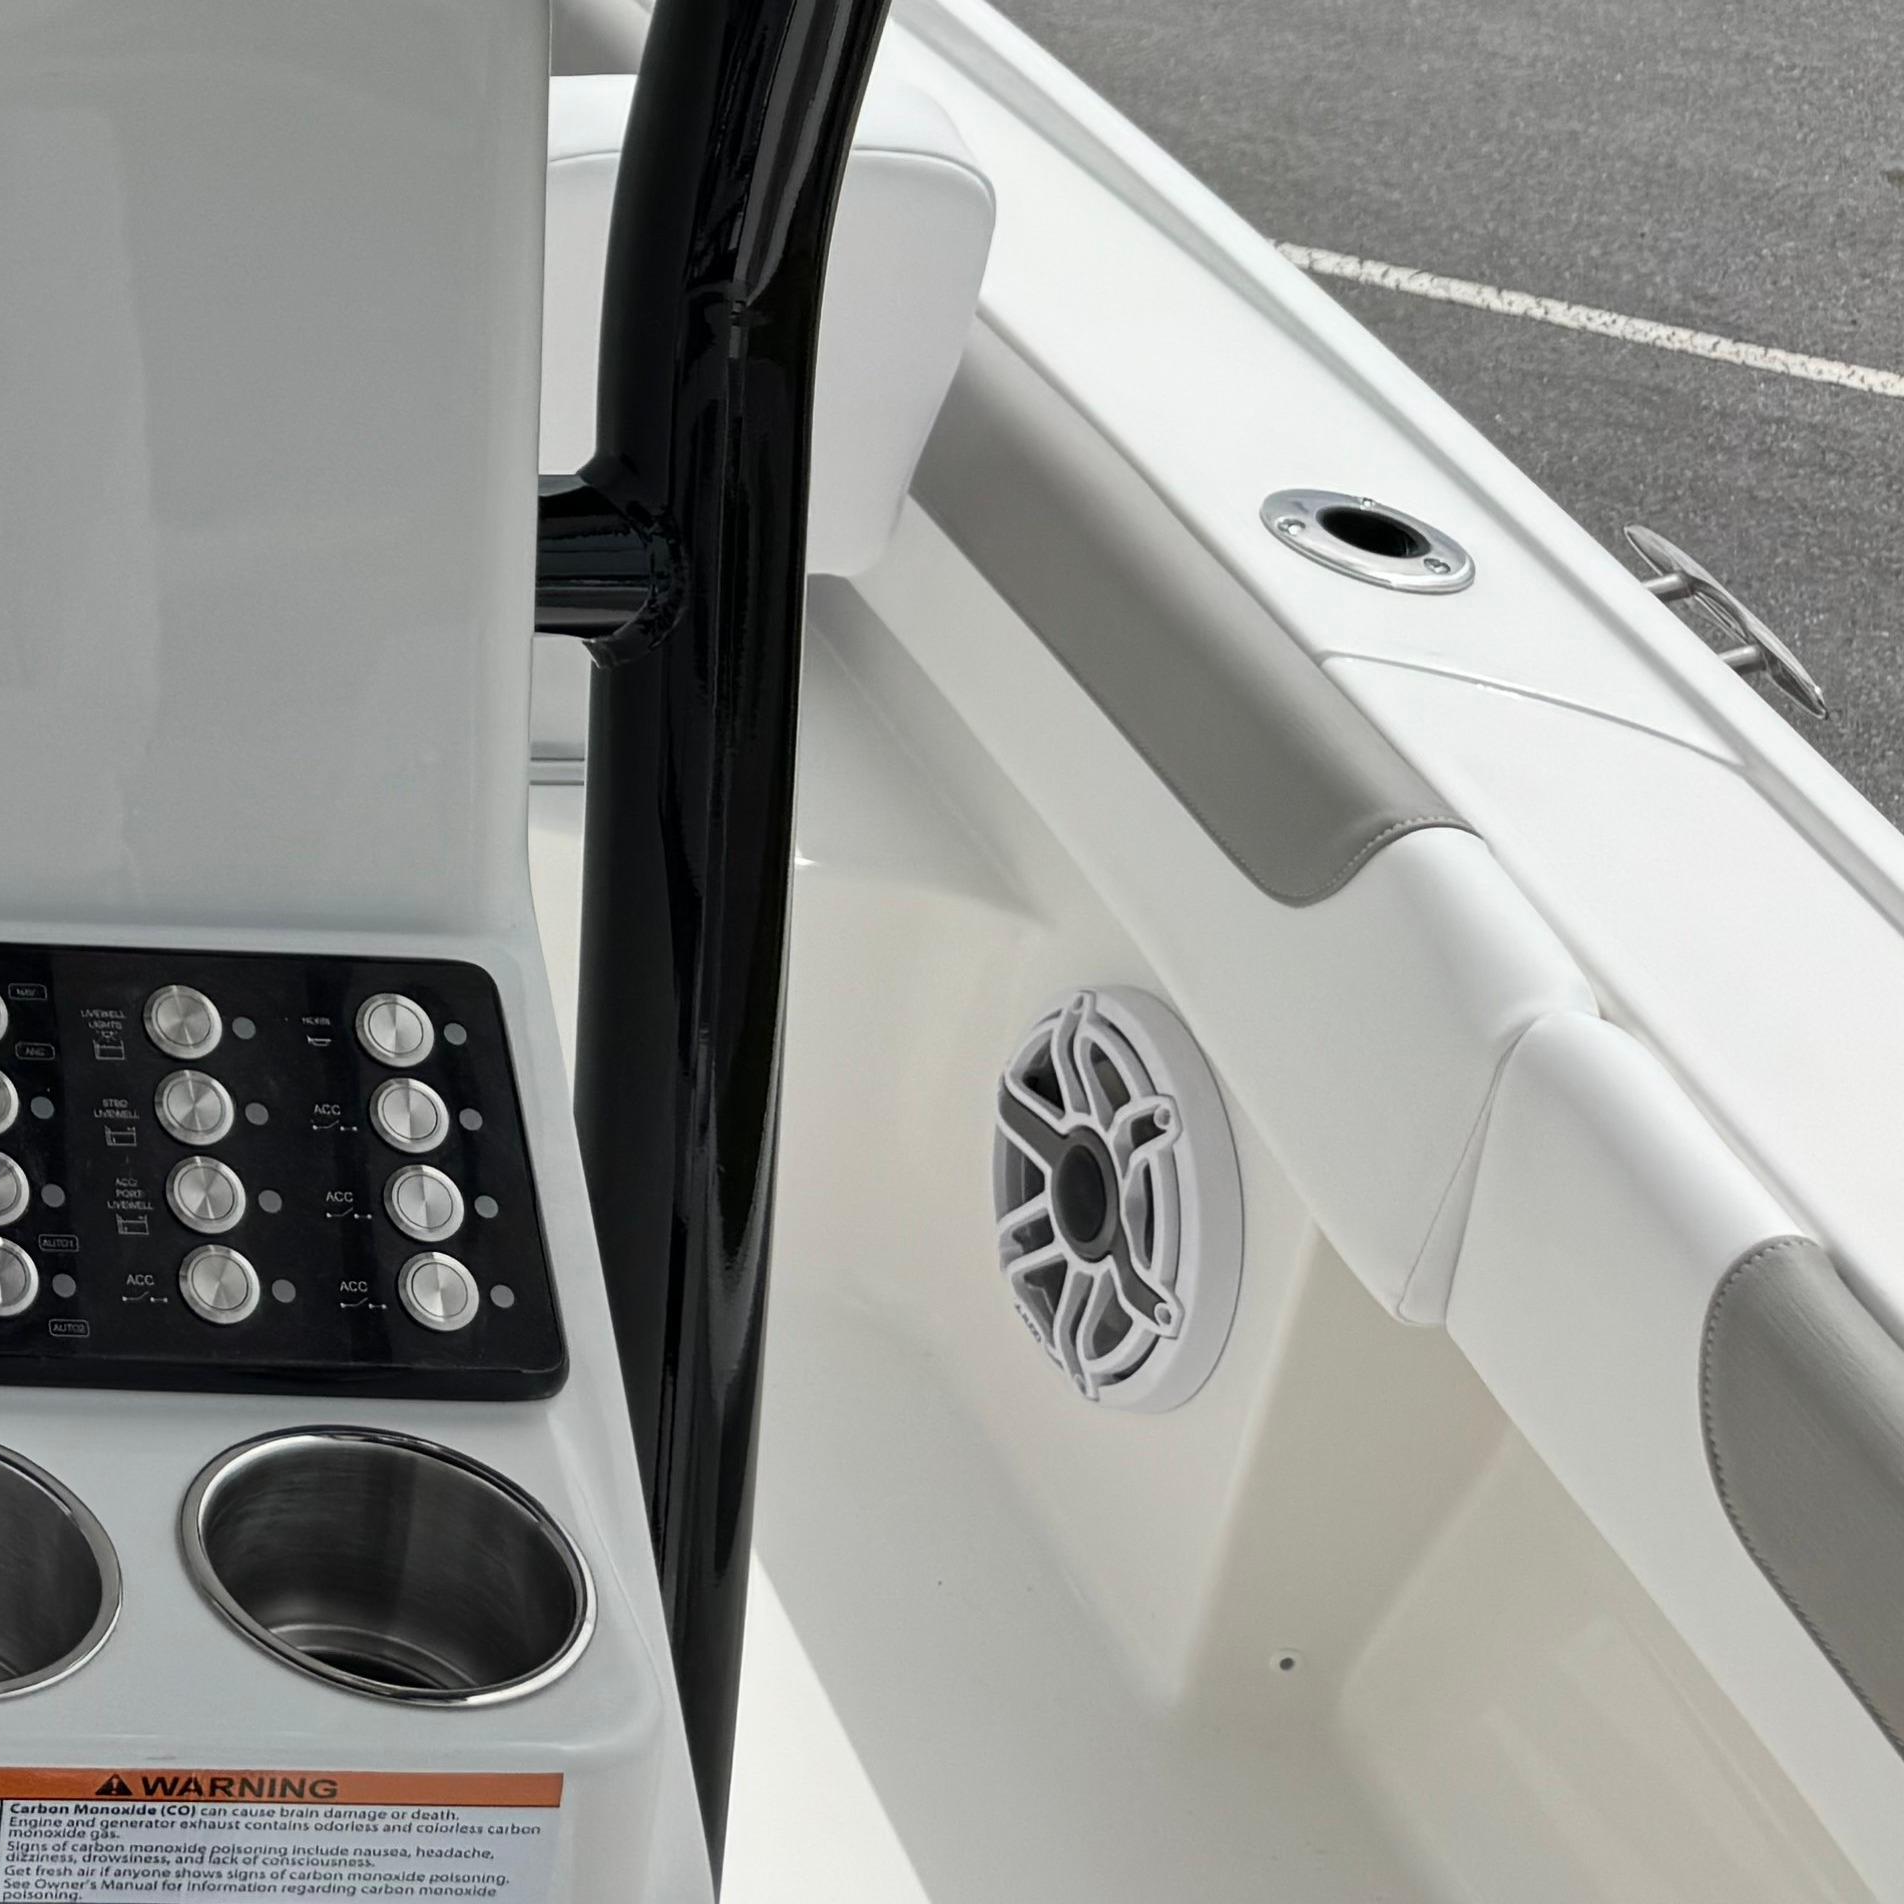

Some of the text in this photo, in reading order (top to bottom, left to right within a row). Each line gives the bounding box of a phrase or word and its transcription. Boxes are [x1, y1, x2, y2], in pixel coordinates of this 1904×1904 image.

[80, 1009, 127, 1019] LIVEWELL
[88, 1020, 123, 1030] LIGHTS
[93, 1109, 140, 1120] LIVEWELL
[313, 1103, 341, 1116] ACC
[116, 1189, 142, 1199] PORT
[325, 1191, 354, 1203] ACC
[107, 1200, 154, 1210] LIVEWELL
[126, 1274, 155, 1286] ACC
[339, 1280, 368, 1292] ACC
[141, 1776, 339, 1799] WARNING
[10, 1803, 460, 1821] Carbon Monoxide (CO) can cause brain damage or death.
[9, 1816, 541, 1835] Engine and generator exhaust contains odorless and colorless carbon
[8, 1828, 121, 1841] monoxide gas.
[7, 1841, 494, 1859] Signs of carbon monoxide poisoning include nausea, headache,
[6, 1852, 375, 1867] dizziness, drowsiness, and lack of consciousness.
[4, 1865, 510, 1886] Get fresh air if anyone shows signs of carbon monoxide poisoning.
[3, 1878, 496, 1897] See Owner's Manual for information regarding carbon monoxide
[3, 1890, 82, 1902] poisoning.
